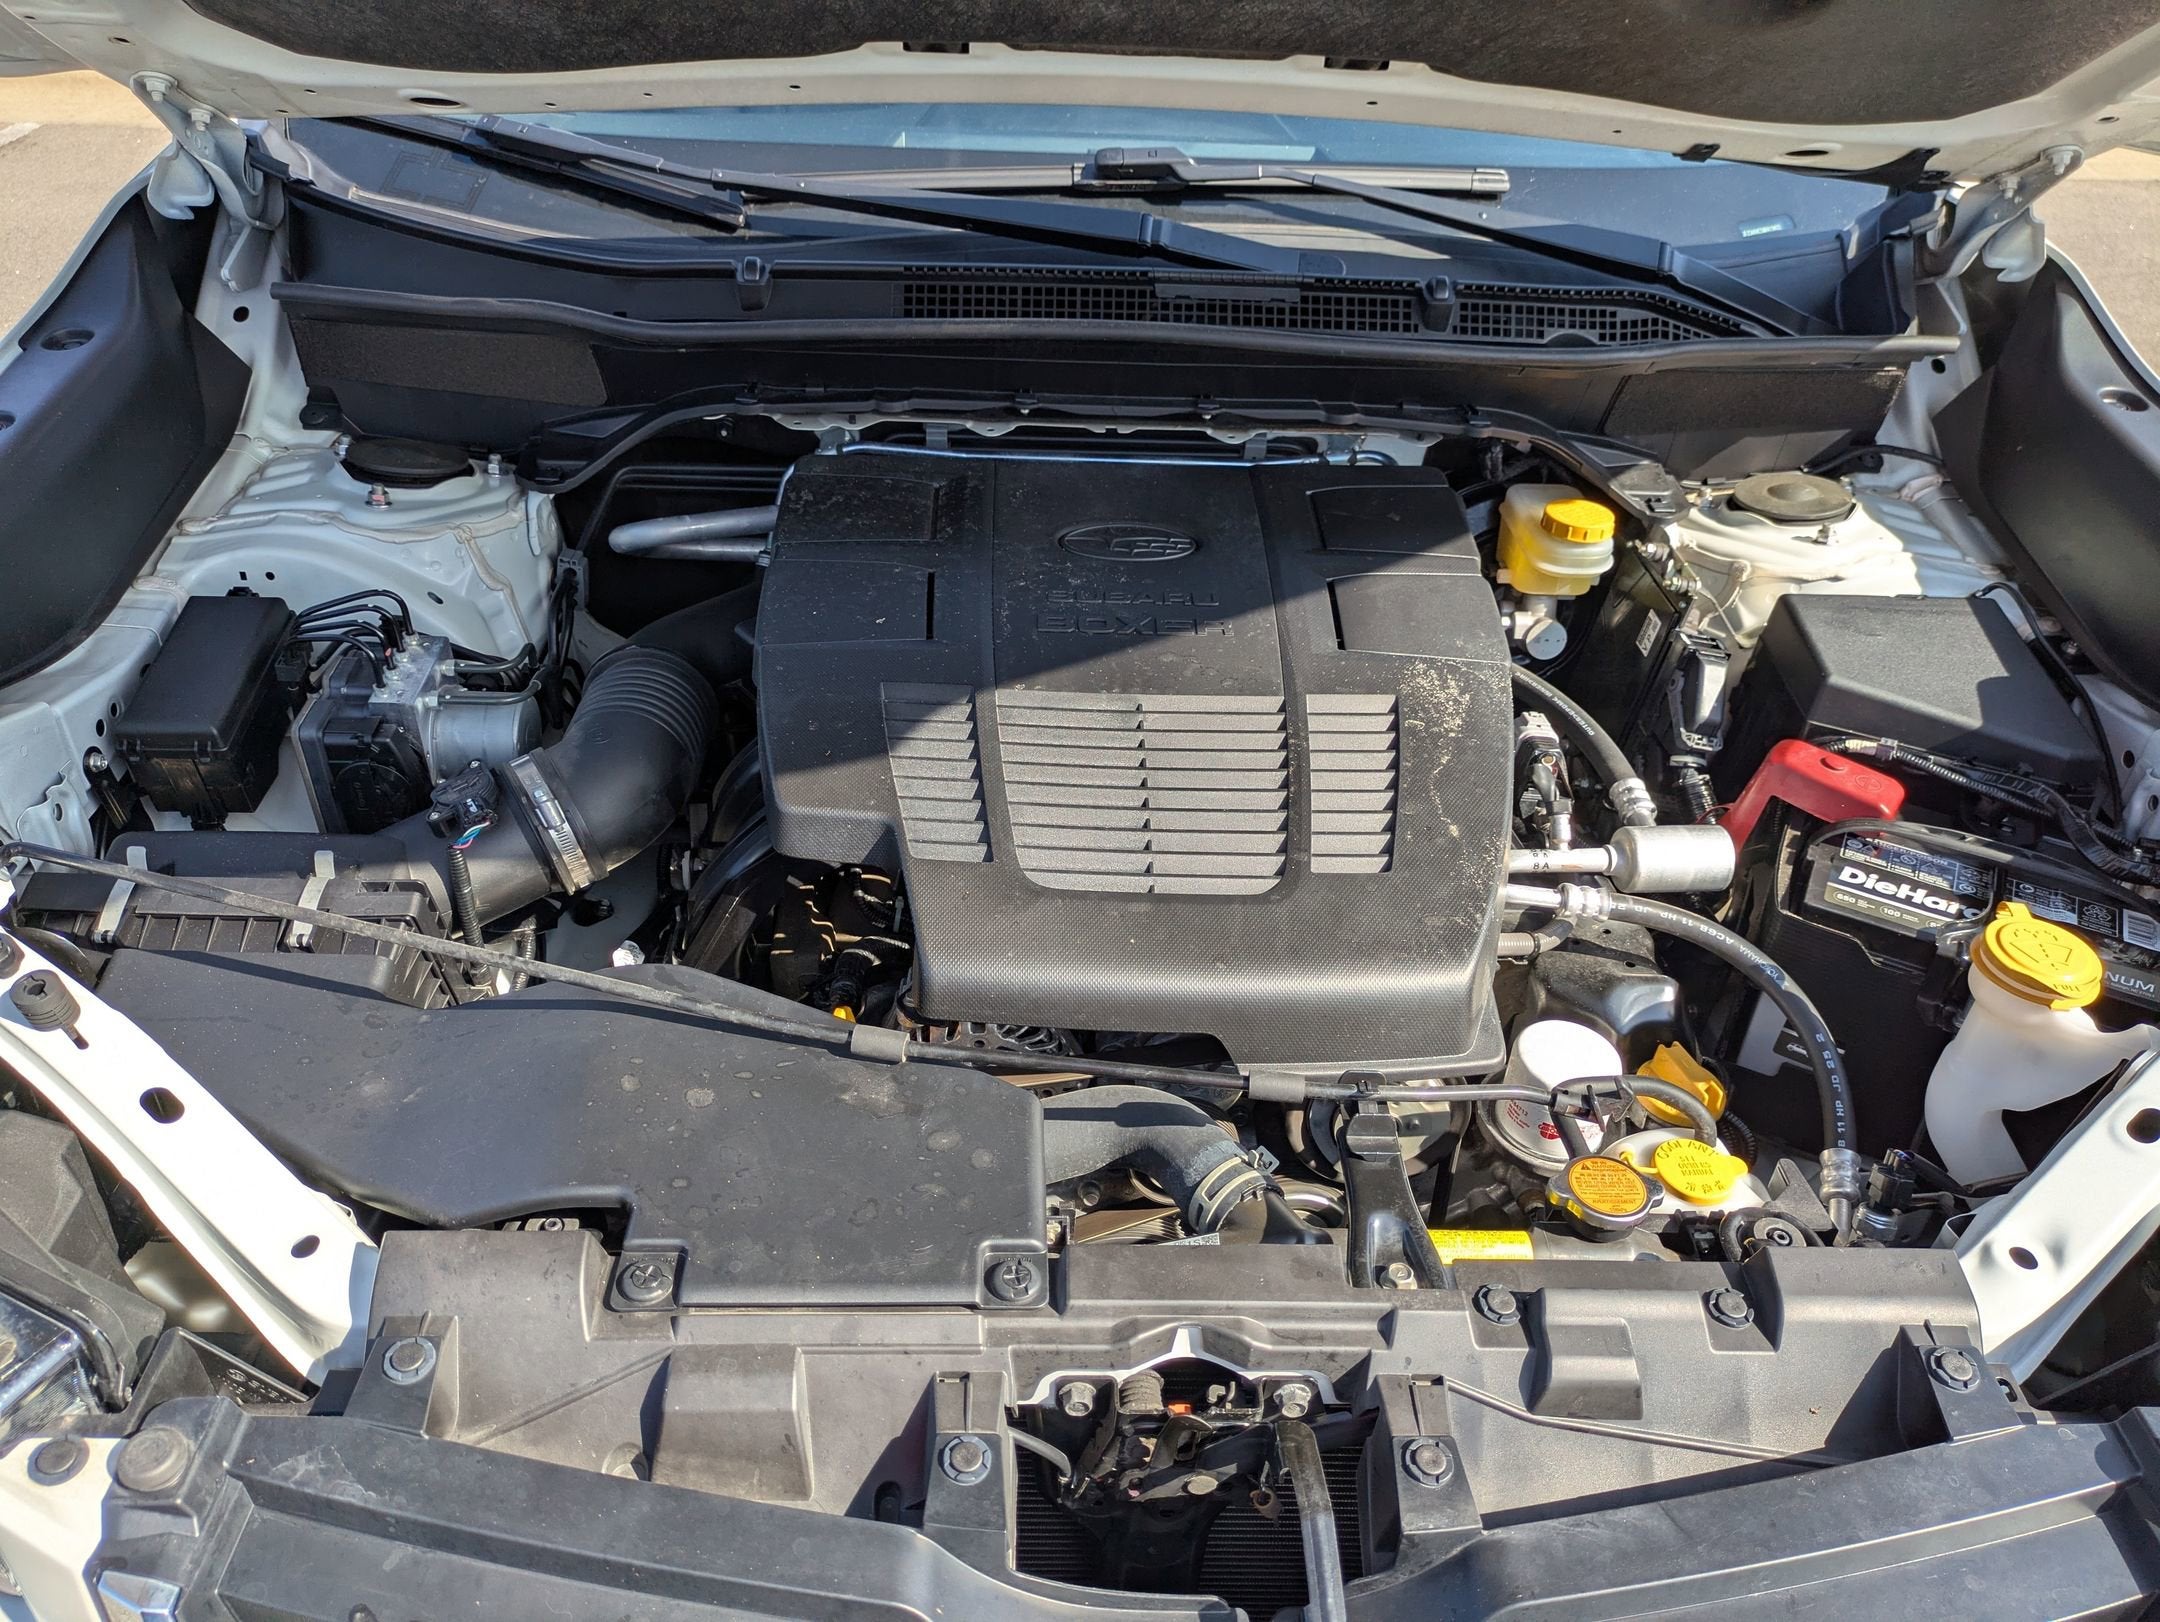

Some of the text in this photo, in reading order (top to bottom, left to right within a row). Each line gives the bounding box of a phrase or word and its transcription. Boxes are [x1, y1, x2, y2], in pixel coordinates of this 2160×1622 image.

[1046, 589, 1220, 607] SUBARU
[1036, 613, 1235, 637] BOXER
[1634, 904, 1650, 913] JD
[1660, 910, 1677, 921] HP
[1882, 905, 1902, 918] 100
[1739, 945, 1779, 980] YOKOHAMA
[1831, 1074, 1841, 1093] JD
[1835, 1100, 1845, 1117] HP
